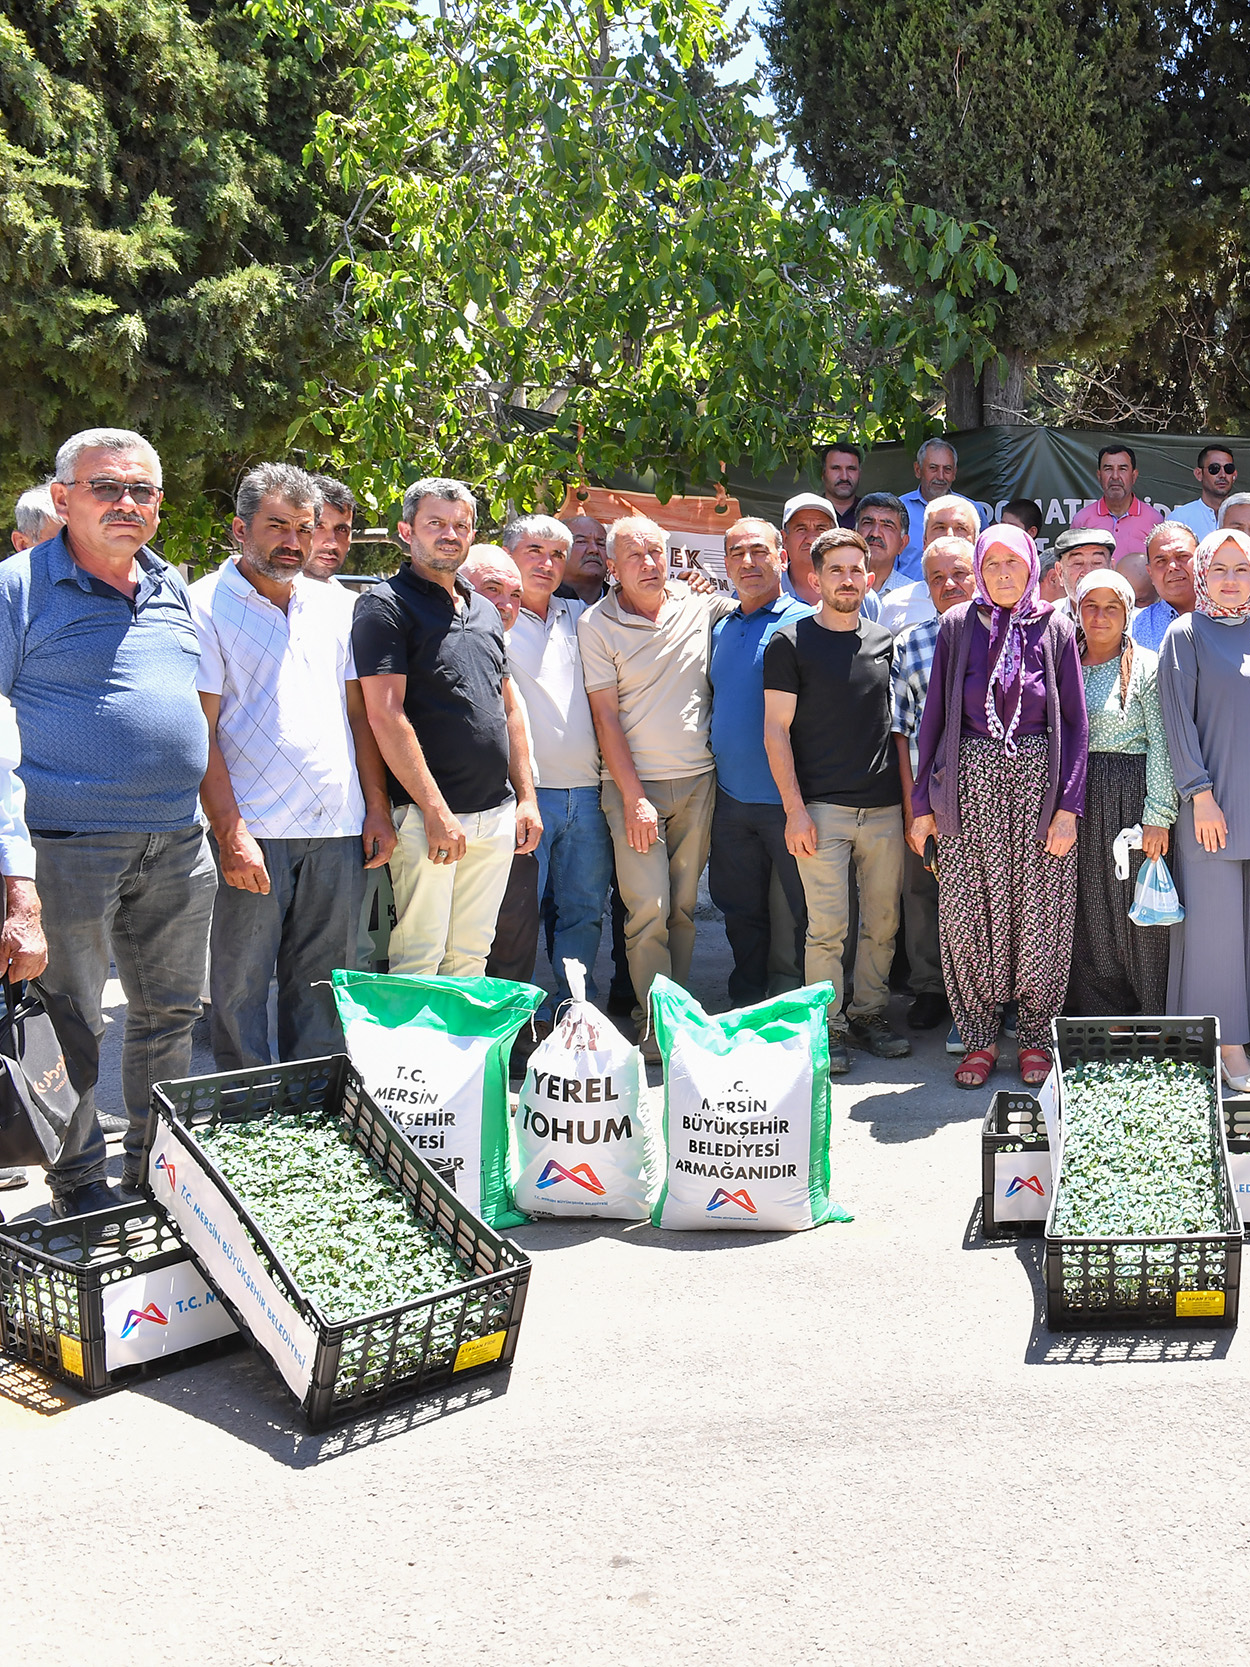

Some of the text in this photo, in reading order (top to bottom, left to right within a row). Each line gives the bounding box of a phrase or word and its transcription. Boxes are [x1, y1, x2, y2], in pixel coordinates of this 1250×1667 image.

[396, 1066, 426, 1084] T.C.
[533, 1068, 619, 1104] YEREL
[374, 1087, 439, 1105] MERSİN
[522, 1104, 633, 1145] TOHUM
[682, 1113, 789, 1139] BÜYÜKŞEHİR
[688, 1139, 780, 1157] BELEDİYESİ
[675, 1158, 797, 1180] ARMAĞANIDIR
[180, 1184, 307, 1369] T.C. MERSİN BÜYÜKŞEHİR BELEDİYESİ
[176, 1298, 202, 1313] T.C.
